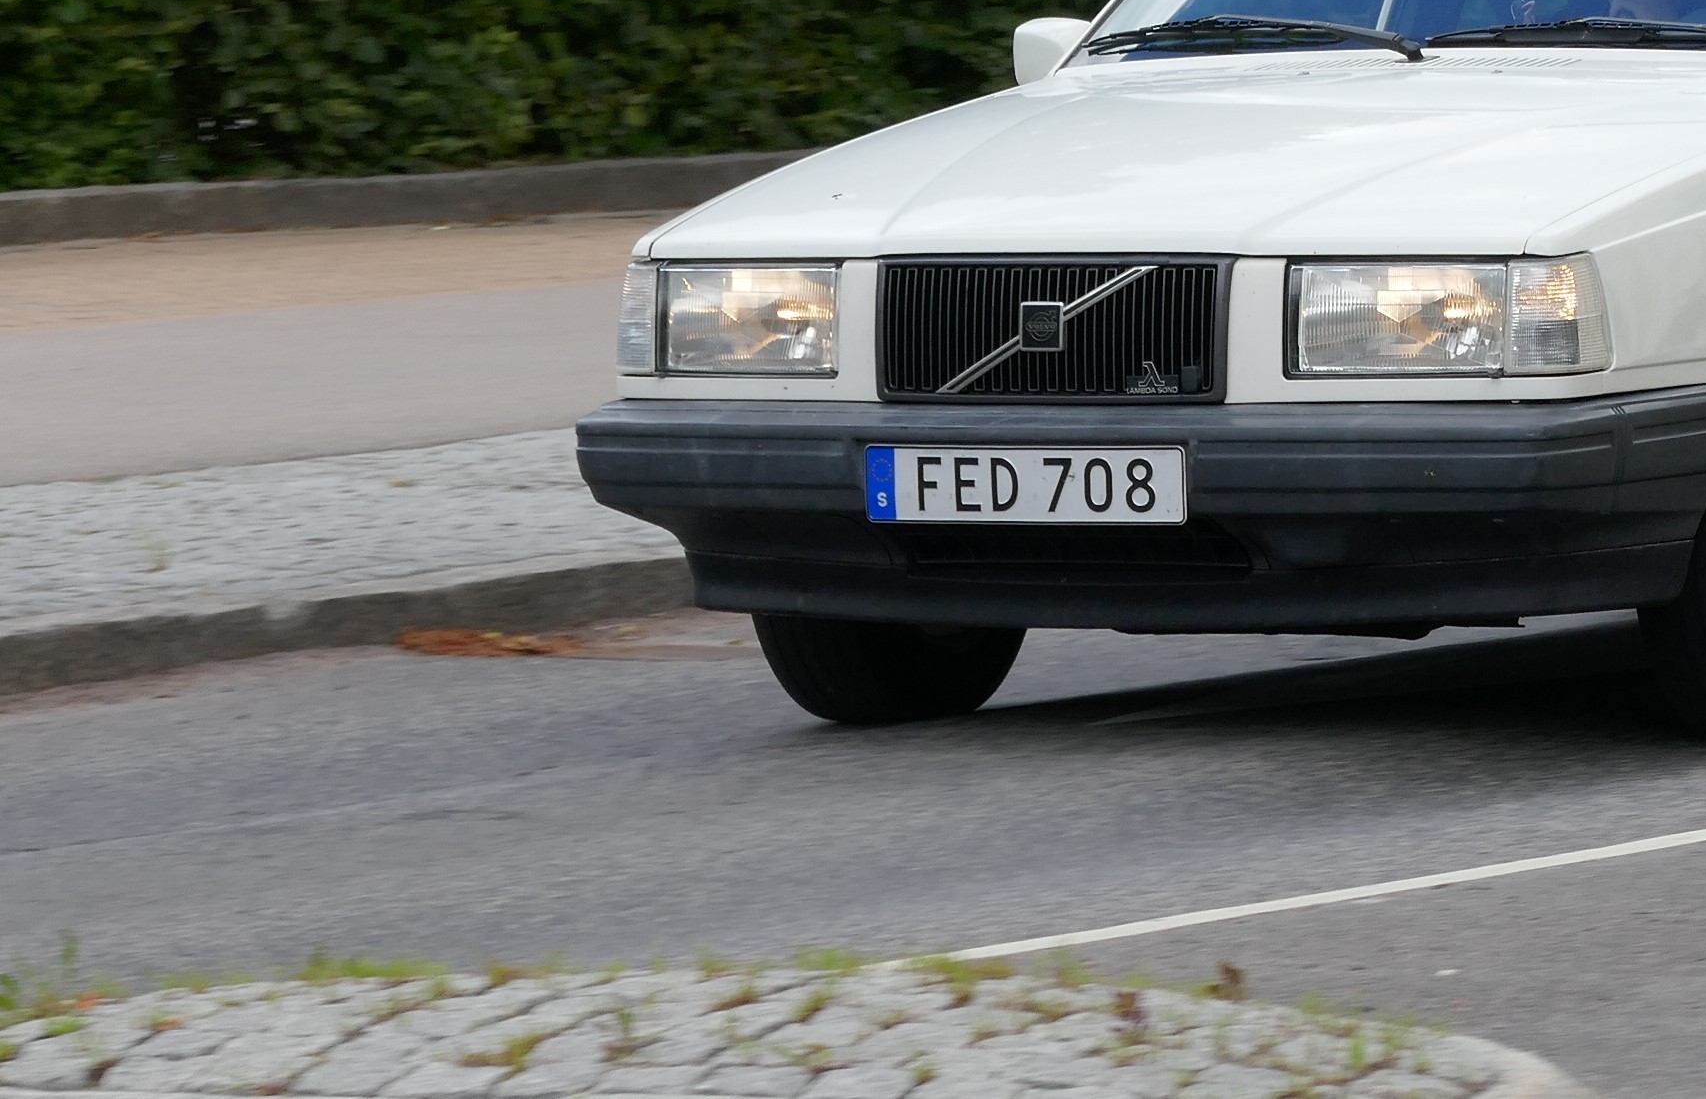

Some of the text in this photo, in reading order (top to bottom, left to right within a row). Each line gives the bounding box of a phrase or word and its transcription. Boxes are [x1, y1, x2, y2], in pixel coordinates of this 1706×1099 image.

[1126, 386, 1178, 395] LAMBDA SOND
[916, 456, 1156, 514] FED 708
[876, 492, 888, 508] S
